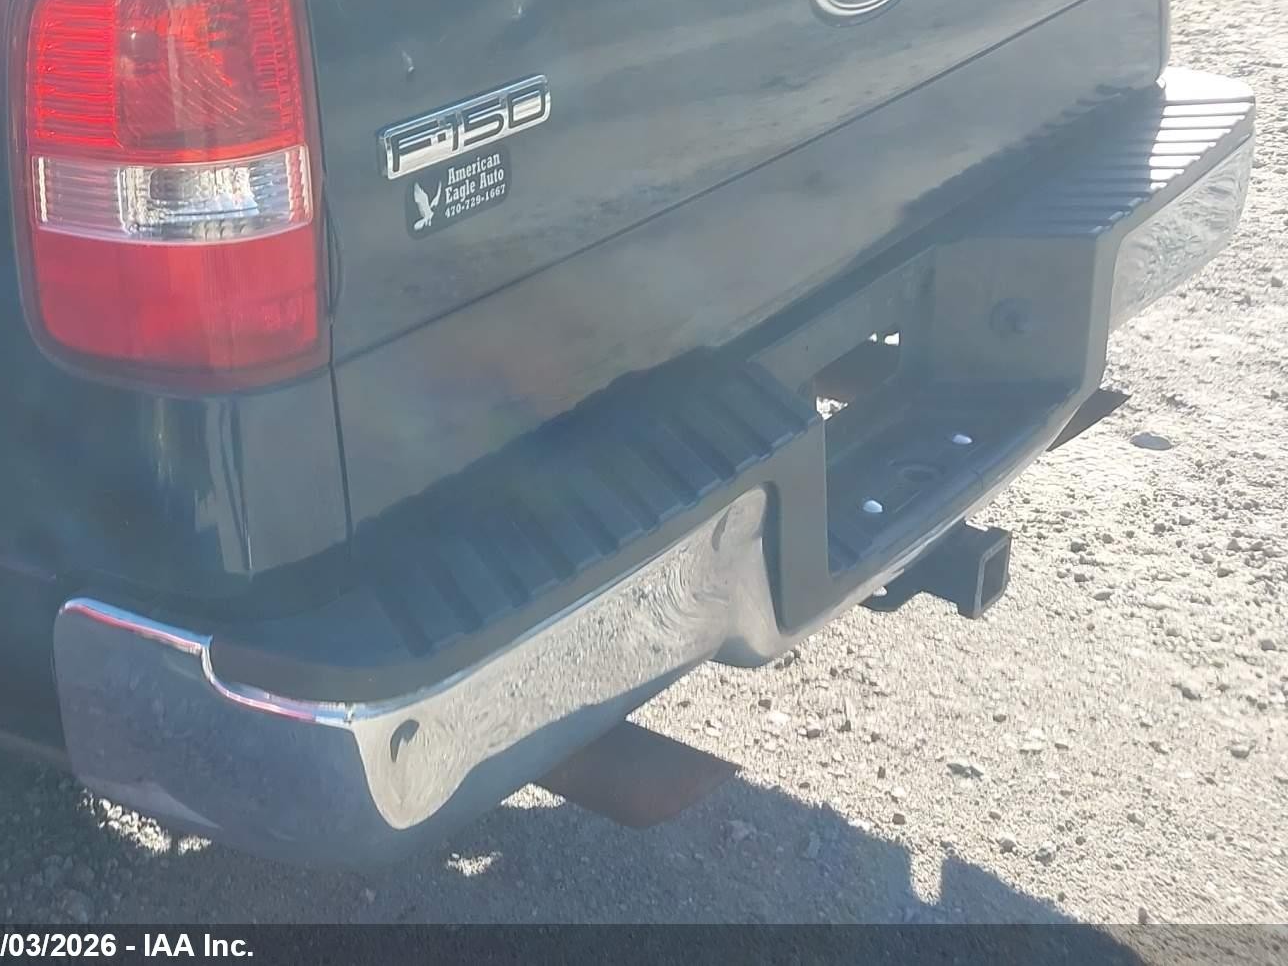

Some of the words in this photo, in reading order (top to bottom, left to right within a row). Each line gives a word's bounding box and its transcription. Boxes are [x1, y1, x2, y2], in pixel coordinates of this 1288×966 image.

[444, 179, 476, 204] Eagle
[479, 168, 505, 189] Auto
[447, 153, 501, 185] American
[444, 184, 506, 218] 470-729-1667
